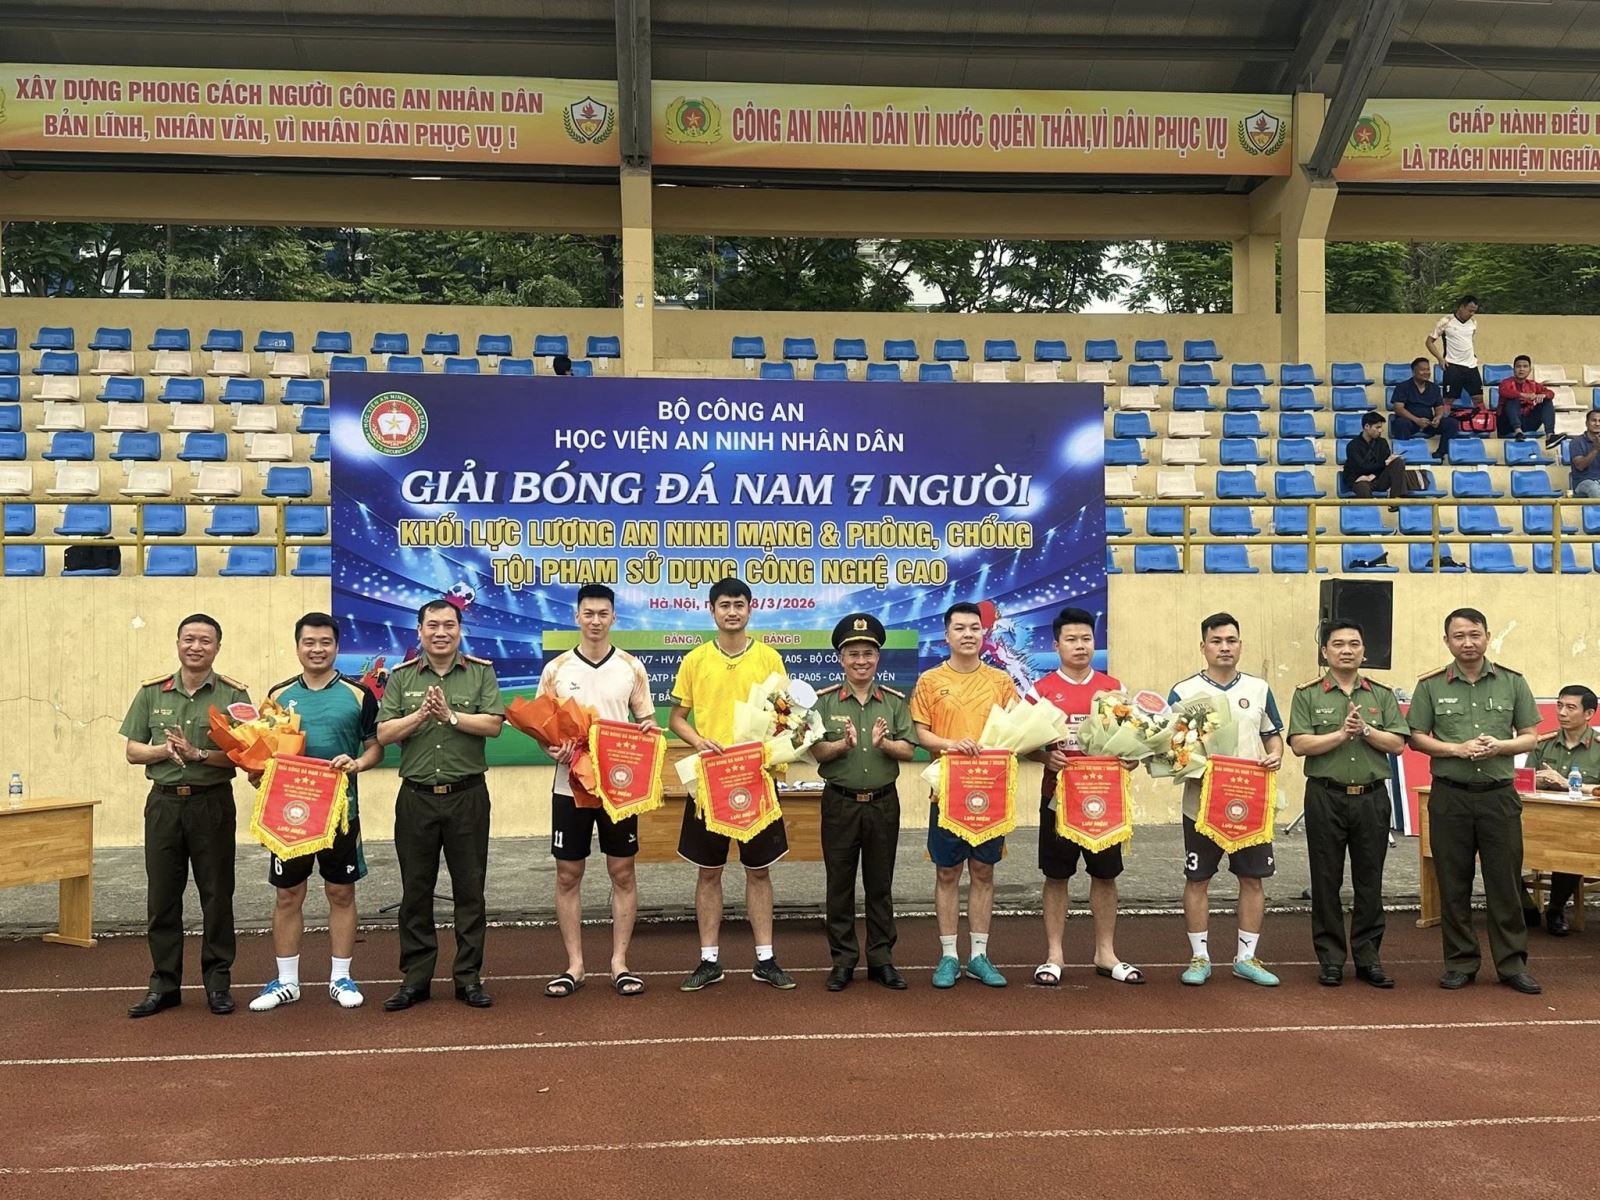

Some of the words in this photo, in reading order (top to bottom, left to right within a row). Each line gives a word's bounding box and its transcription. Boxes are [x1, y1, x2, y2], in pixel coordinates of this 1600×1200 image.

[16, 74, 57, 99] XÂY
[64, 78, 121, 105] DỰNG
[128, 81, 200, 104] PHONG
[206, 80, 262, 104] CÁCH
[269, 81, 332, 107] NGƯỜI
[340, 83, 396, 108] CÔNG
[402, 89, 430, 110] AN
[438, 86, 494, 112] NHÂN
[502, 88, 543, 113] DÂN
[44, 108, 88, 136] BẢN
[95, 112, 149, 140] LĨNH,
[156, 114, 215, 139] NHÂN
[221, 114, 269, 142] VĂN,
[276, 116, 295, 140] VÌ
[302, 118, 360, 142] NHÂN
[366, 119, 408, 144] DÂN
[415, 124, 470, 150] PHỤC
[476, 126, 502, 152] VỤ
[732, 101, 781, 142] CÔNG
[786, 109, 812, 142] AN
[817, 104, 866, 144] NHÂN
[872, 104, 908, 145] DÂN
[914, 106, 930, 145] VÌ
[936, 106, 983, 146] NƯỚC
[989, 108, 1035, 150] QUÊN
[1114, 109, 1149, 148] DÂN
[1154, 116, 1200, 158] PHỤC
[1206, 118, 1228, 158] VỤ
[1449, 105, 1494, 134] CHẤP
[1500, 108, 1546, 134] HÀNH
[1402, 144, 1424, 170] LÀ
[1429, 144, 1483, 170] TRÁCH
[1489, 144, 1544, 174] NHIỆM
[1550, 146, 1600, 171] NGHĨA
[658, 397, 690, 424] BỘ
[697, 398, 764, 422] CÔNG
[770, 403, 804, 422] AN
[555, 429, 606, 453] HỌC
[612, 426, 668, 454] VIỆN
[674, 431, 708, 450] AN
[716, 432, 774, 450] NINH
[782, 428, 848, 452] NHÂN
[856, 428, 904, 452] DÂN
[400, 459, 499, 504] GIẢI
[509, 460, 642, 505] BÓNG
[655, 462, 720, 505] ĐÁ
[731, 473, 835, 505] NAM
[850, 474, 875, 506] 7
[885, 464, 1032, 506] NGƯỜI
[400, 512, 463, 546] KHỐI
[472, 520, 520, 550] LỰC
[529, 519, 614, 551] LƯỢNG
[622, 522, 657, 547] AN
[666, 522, 729, 547] NINH
[736, 522, 812, 552] MẠNG
[820, 522, 839, 548] &
[847, 516, 940, 550] PHÒNG,
[947, 515, 1032, 548] CHỐNG
[493, 555, 534, 590] TỘI
[626, 552, 664, 584] SỬ
[668, 560, 738, 589] DỤNG
[746, 555, 814, 584] CÔNG
[822, 555, 888, 590] NGHỆ
[896, 560, 946, 584] CAO
[650, 598, 668, 609] Hà
[674, 598, 700, 611] Nội,
[750, 598, 816, 610] 8/3/2026
[664, 632, 692, 644] BẢNG
[763, 633, 791, 644] BẢNG
[794, 636, 800, 644] B
[661, 656, 674, 664] HV
[784, 655, 802, 663] A05
[810, 652, 823, 664] BỘ
[554, 830, 564, 848] 11
[274, 857, 283, 875] 6
